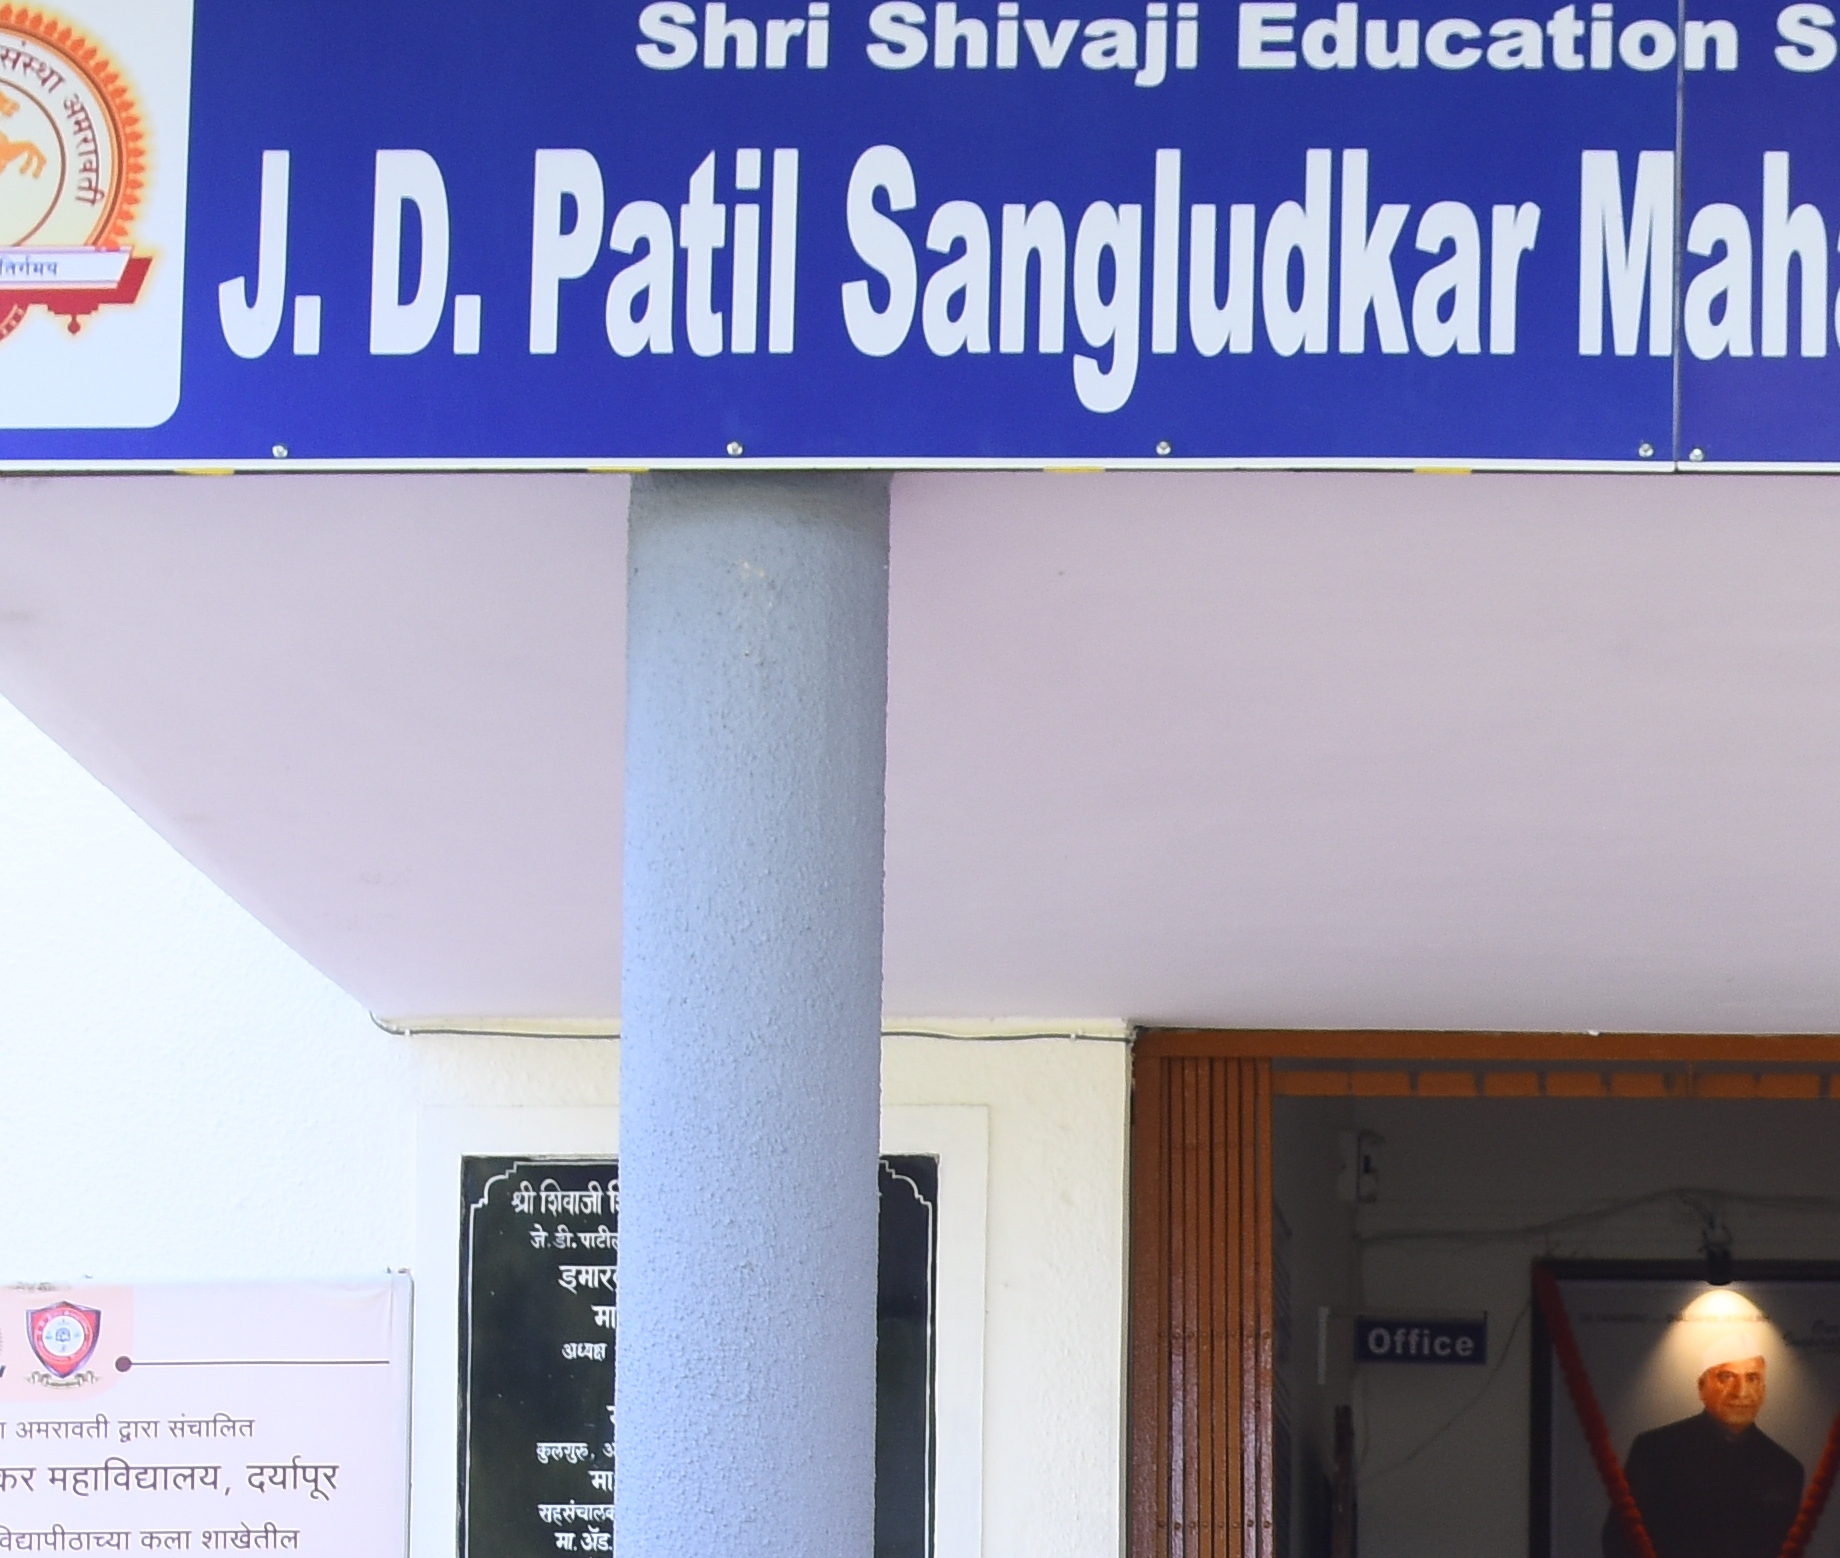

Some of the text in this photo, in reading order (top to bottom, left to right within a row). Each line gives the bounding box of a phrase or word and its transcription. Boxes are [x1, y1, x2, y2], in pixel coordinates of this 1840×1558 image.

[635, 0, 829, 70] Shri
[866, 0, 1199, 87] Shivaji
[1237, 2, 1740, 72] Education
[0, 40, 67, 93] संस्था
[62, 92, 106, 207] अमरावती
[218, 149, 322, 360] J.
[369, 148, 482, 356] D.
[529, 147, 799, 358] Patil
[841, 144, 1541, 414] Sangludkar
[511, 1180, 537, 1215] श्री
[540, 1178, 604, 1217] शिवाजी
[561, 1342, 608, 1362] अध्यक्ष
[1367, 1327, 1475, 1357] Office
[15, 1413, 110, 1440] अमरावती
[118, 1418, 161, 1443] द्वारा
[168, 1412, 256, 1438] संचालित
[48, 1456, 232, 1497] महाविद्यालय,
[246, 1455, 340, 1501] दर्यापूर
[140, 1530, 192, 1550] कला
[201, 1521, 301, 1550] शाखेतील
